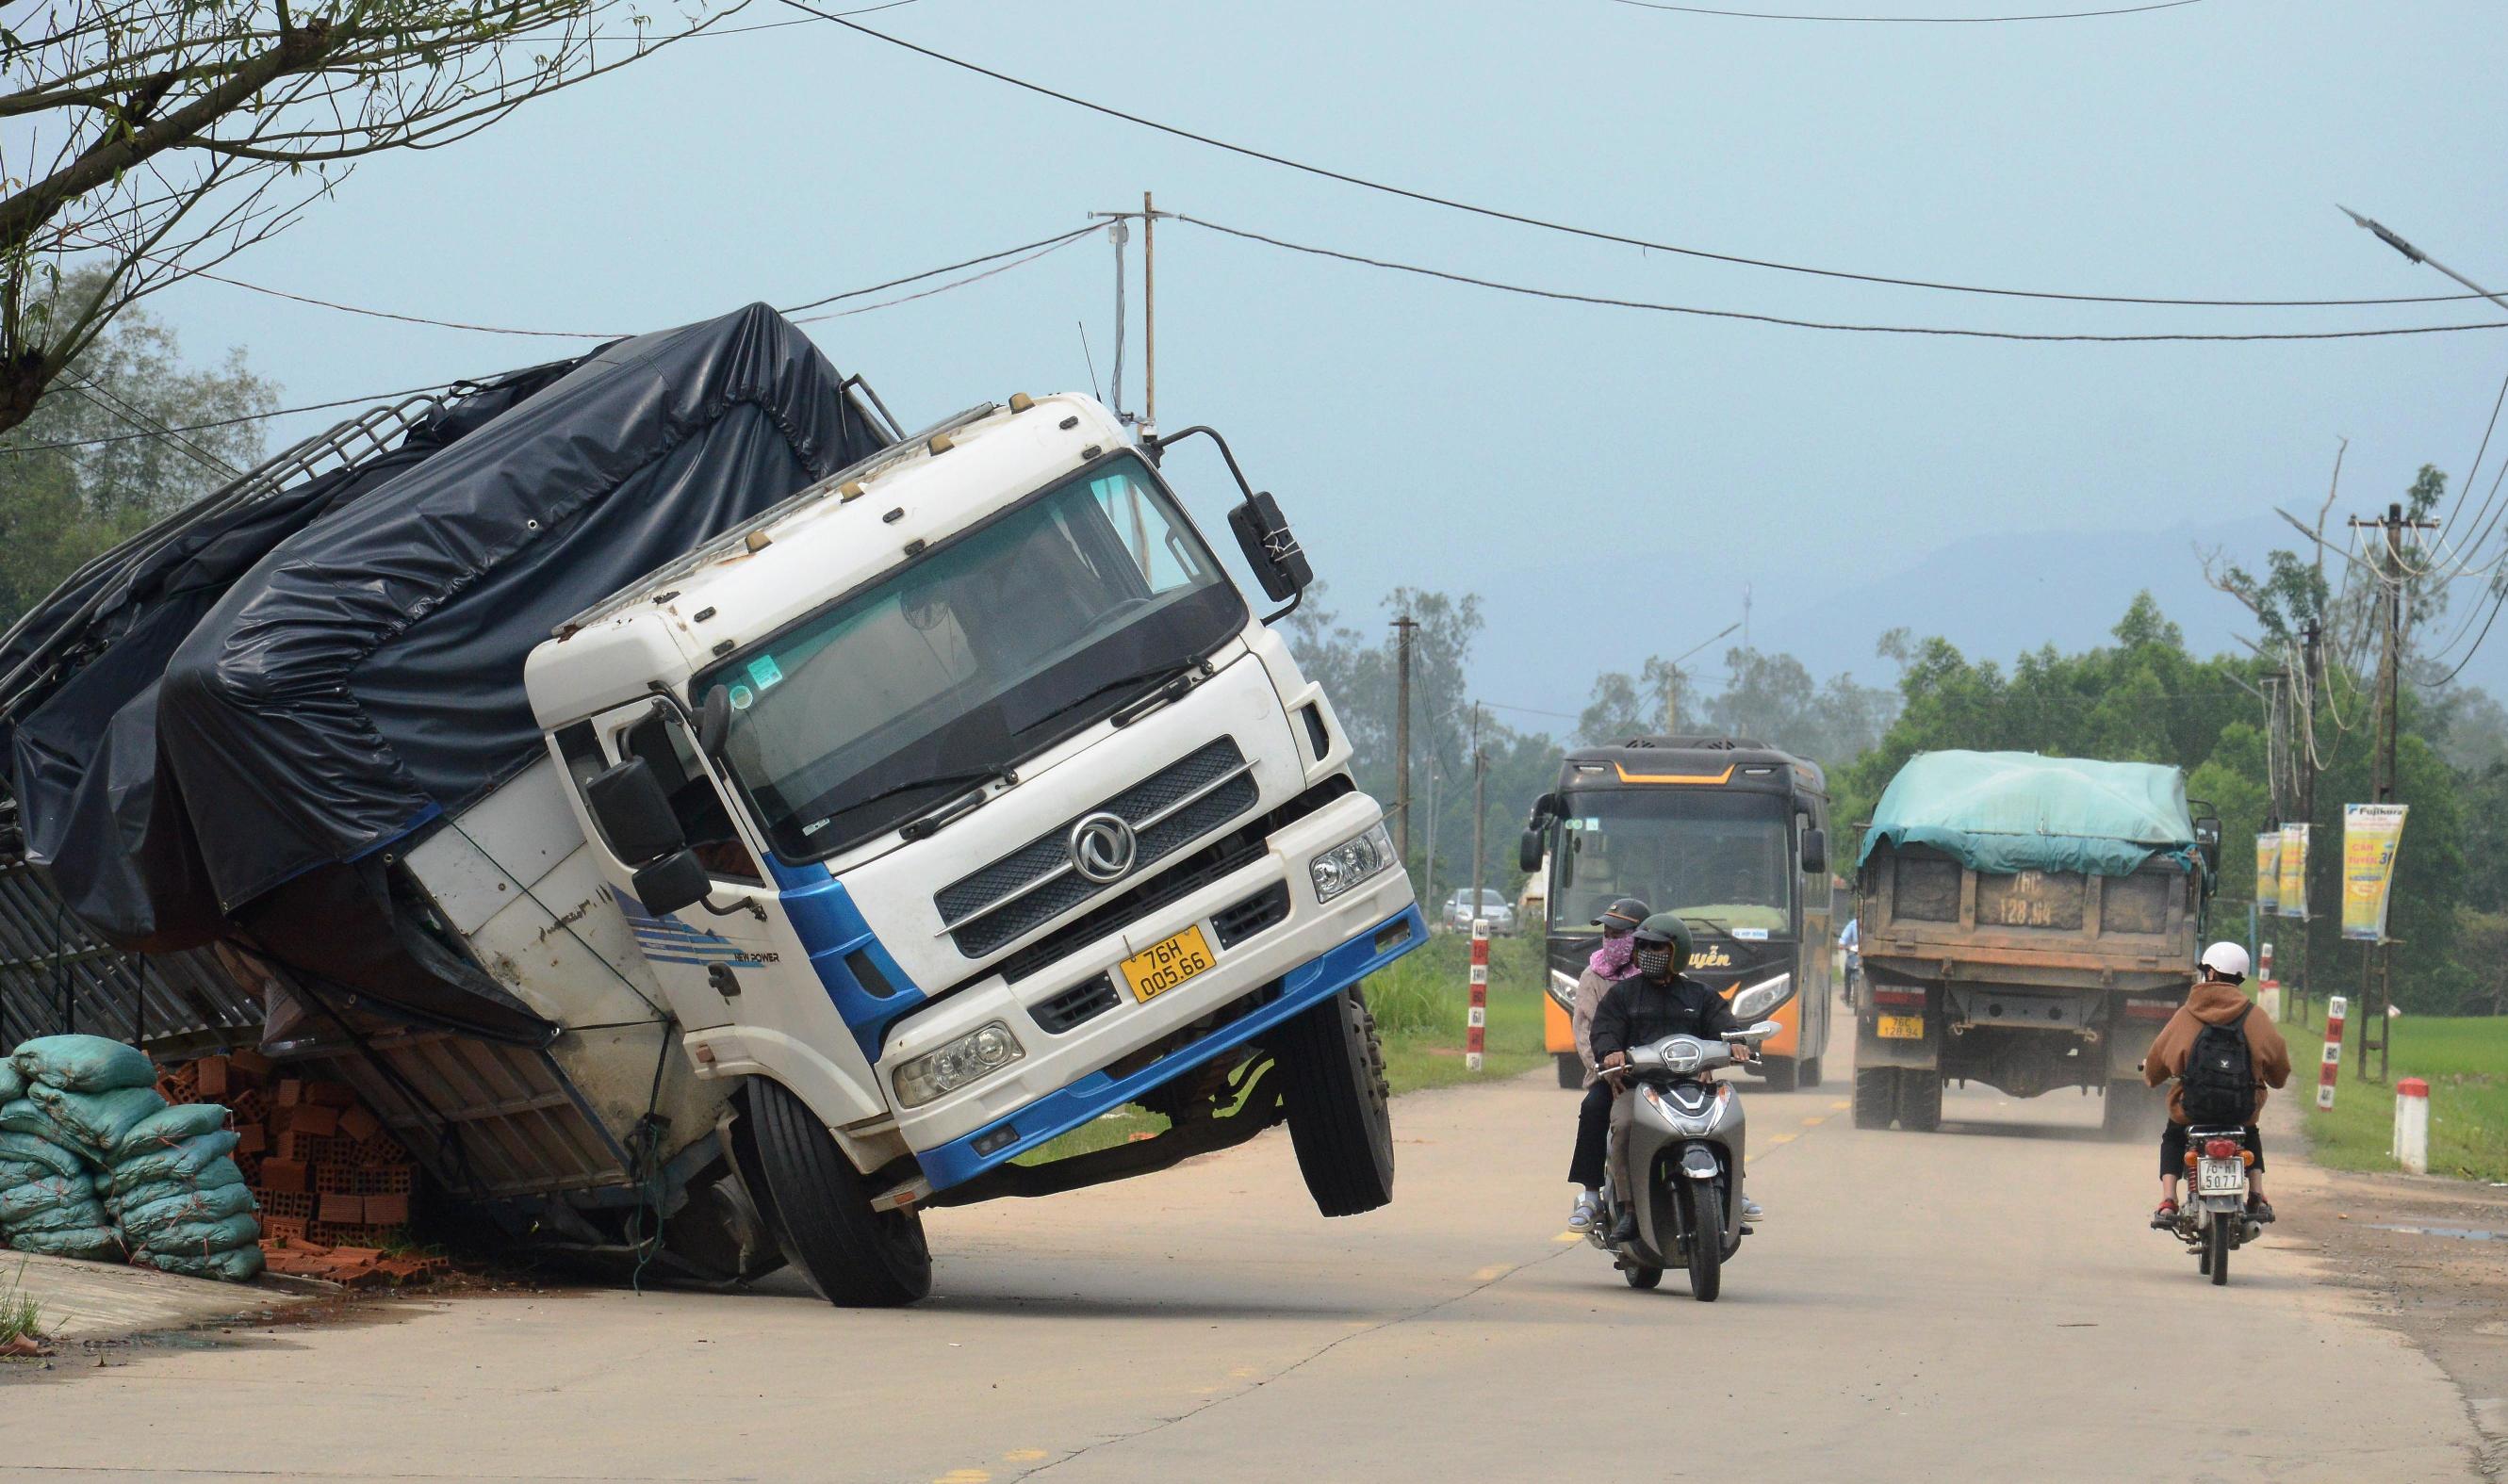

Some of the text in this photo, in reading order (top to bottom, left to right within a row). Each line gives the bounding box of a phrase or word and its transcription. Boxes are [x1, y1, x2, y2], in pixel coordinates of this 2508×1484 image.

[2359, 807, 2402, 817] Fujikura
[734, 952, 780, 963] NEW POWER
[1143, 938, 1183, 970] 76H
[1140, 951, 1205, 997] 005.66
[2205, 1175, 2237, 1188] 5077
